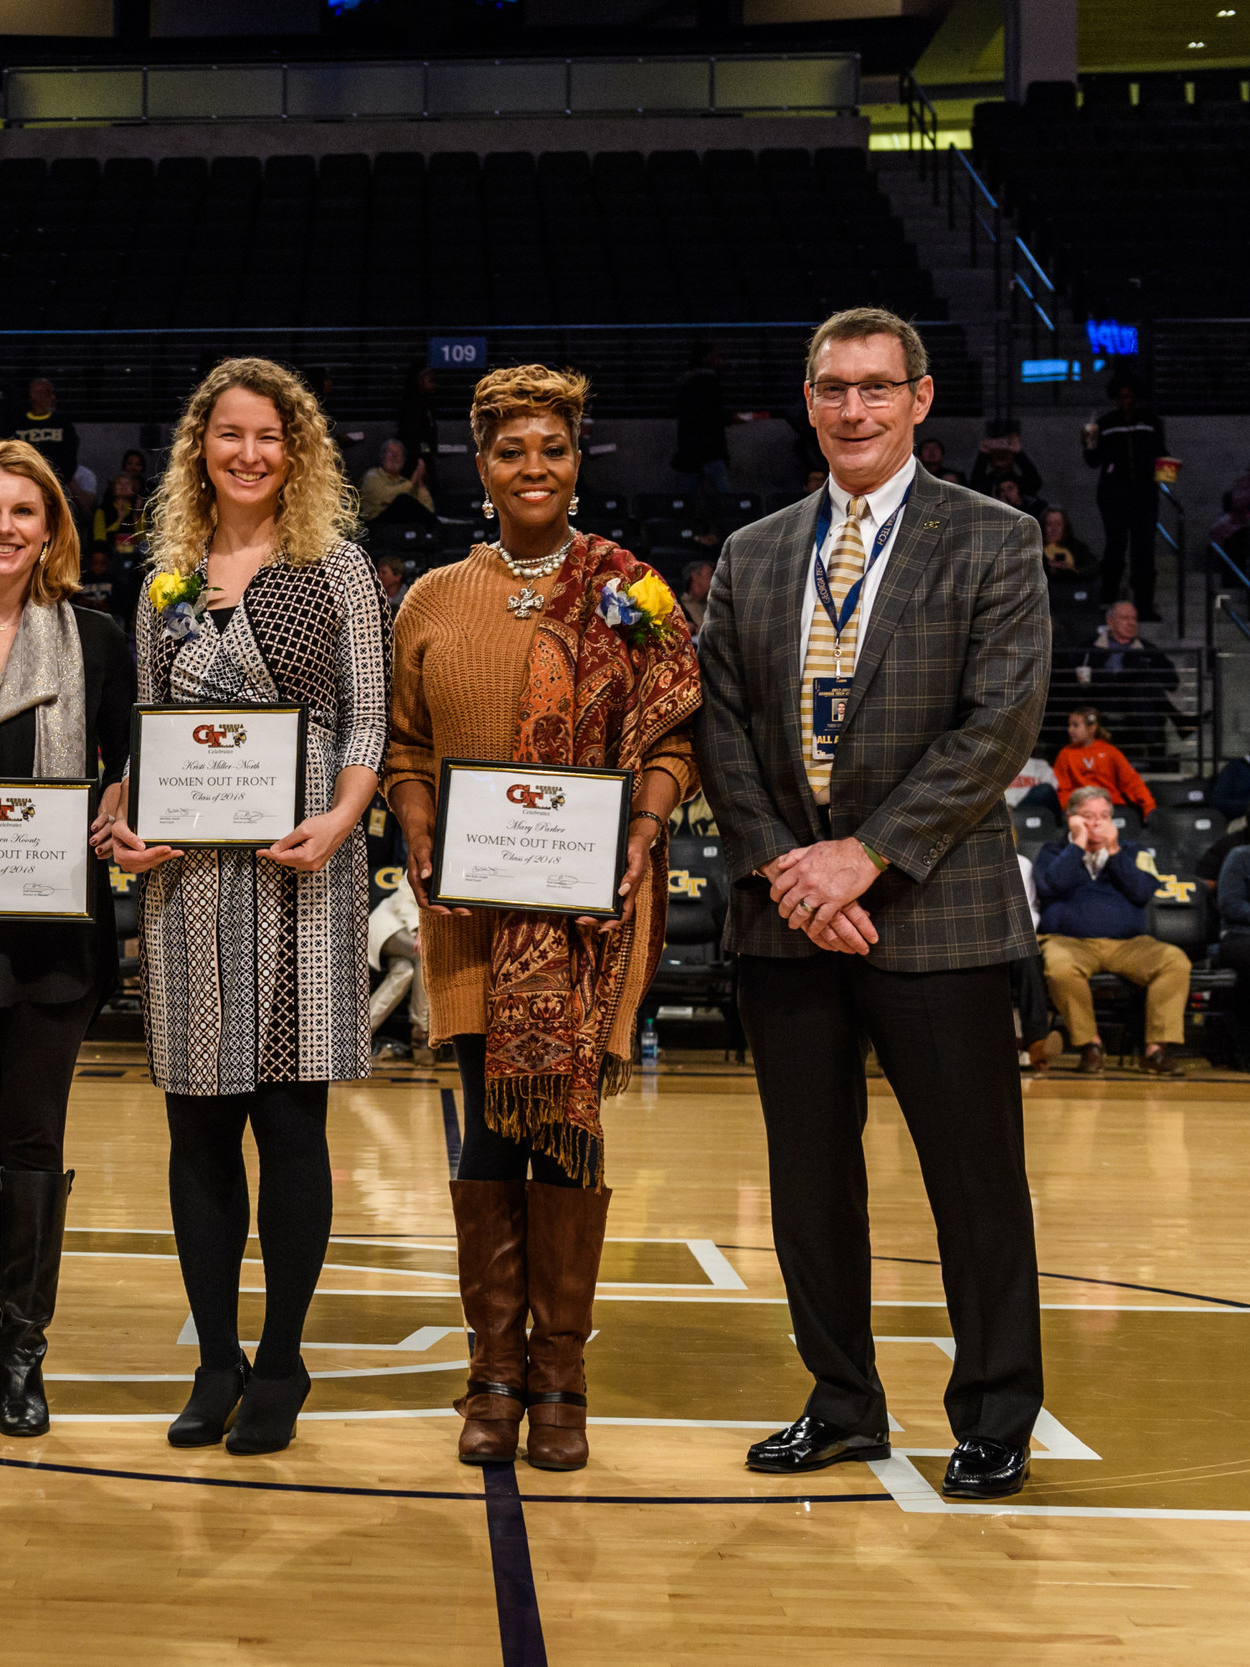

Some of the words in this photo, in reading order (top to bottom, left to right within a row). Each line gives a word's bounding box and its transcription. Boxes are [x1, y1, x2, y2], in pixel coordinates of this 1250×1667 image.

[441, 345, 476, 361] 109
[16, 428, 63, 441] TECH
[877, 527, 891, 546] TECH
[816, 735, 833, 744] ALL
[158, 777, 204, 787] WOMEN
[207, 776, 233, 786] OUT
[236, 776, 277, 786] FRONT
[191, 790, 211, 801] Class
[211, 791, 220, 803] of
[220, 792, 246, 801] 2018
[506, 819, 533, 834] Mary
[534, 822, 566, 833] Parker
[10, 832, 41, 847] Koontz
[466, 833, 516, 847] WOMEN
[520, 837, 549, 849] OUT
[552, 840, 596, 852] FRONT
[25, 850, 67, 860] FRONT
[501, 850, 524, 862] Class
[524, 853, 533, 865] of
[533, 854, 561, 865] 2018
[0, 863, 9, 875] of
[9, 865, 36, 874] 2018
[667, 870, 707, 898] GT
